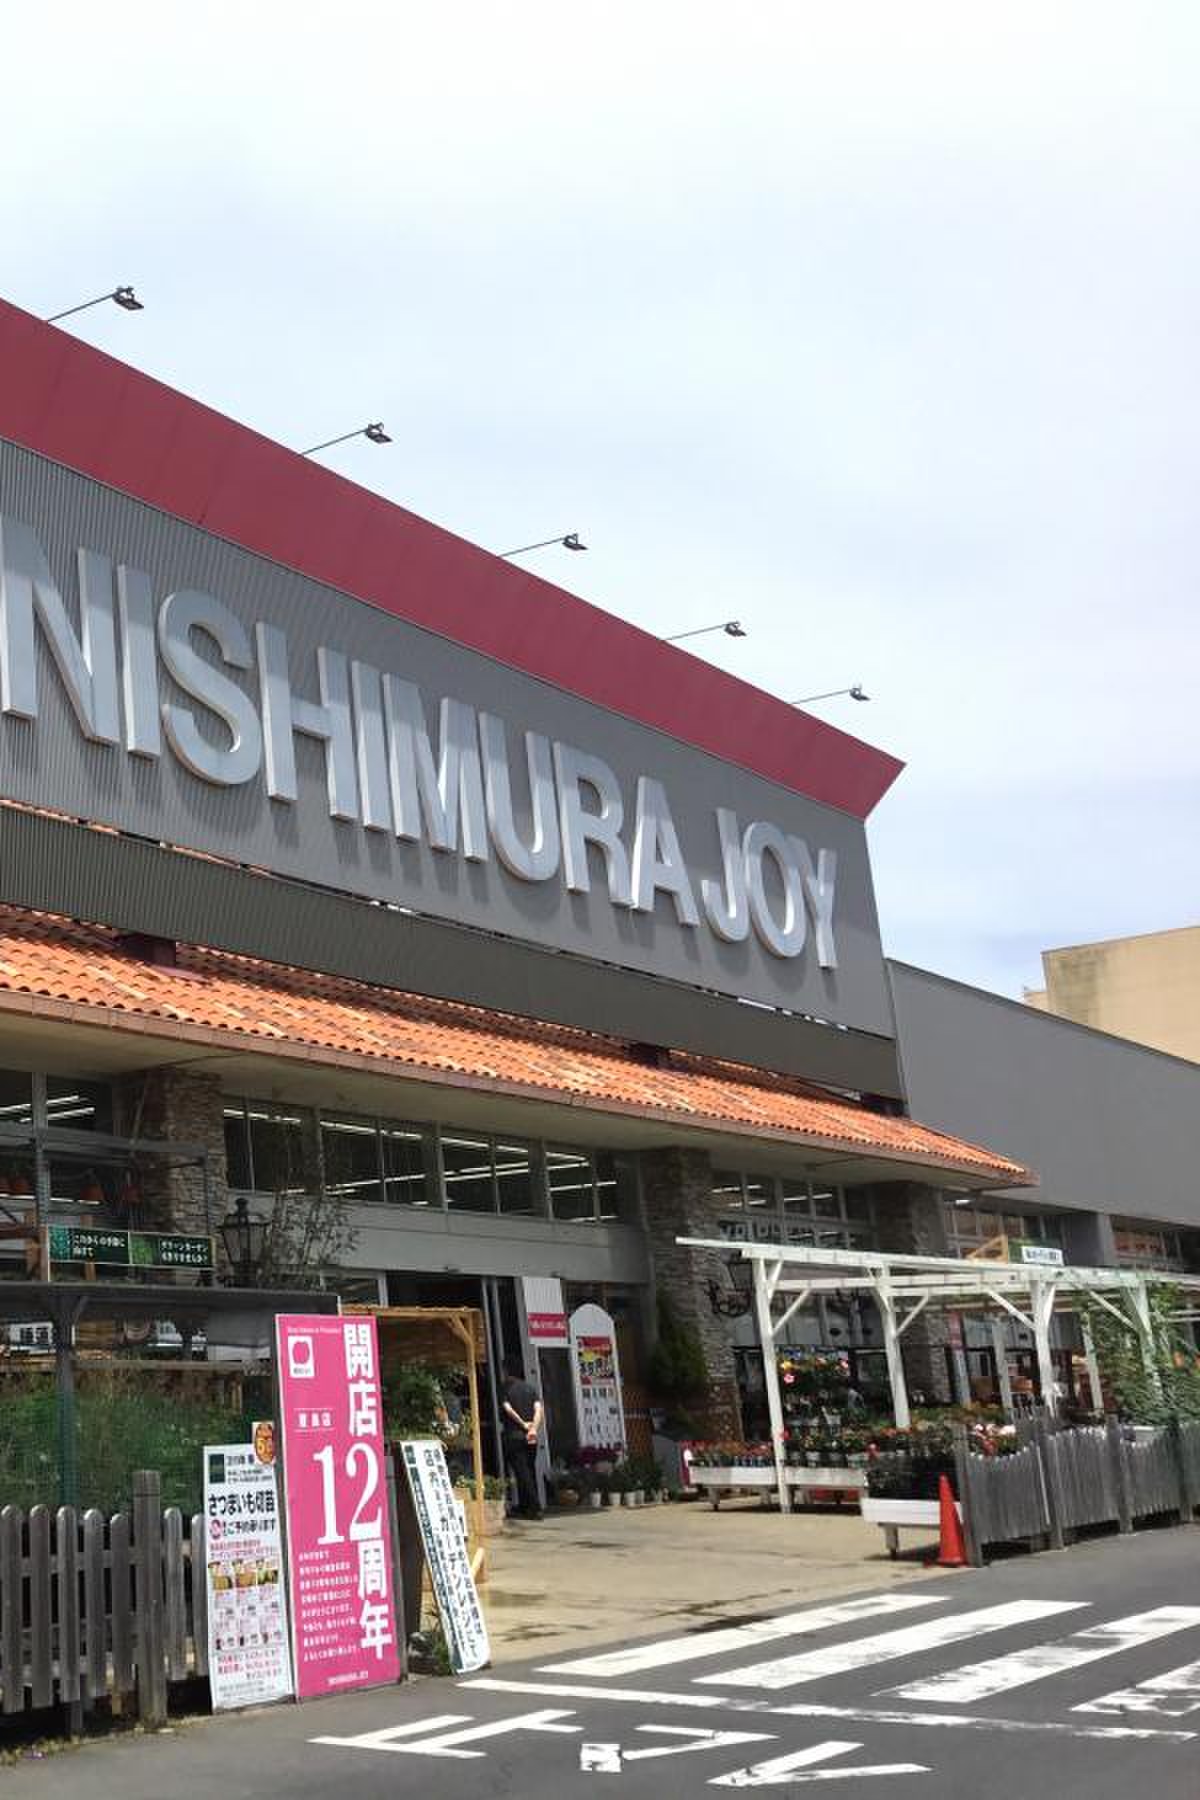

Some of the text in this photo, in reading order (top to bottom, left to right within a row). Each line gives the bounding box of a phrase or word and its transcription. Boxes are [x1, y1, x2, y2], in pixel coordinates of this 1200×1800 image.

[701, 808, 840, 970] JOY
[312, 1323, 392, 1660] 開店12周年
